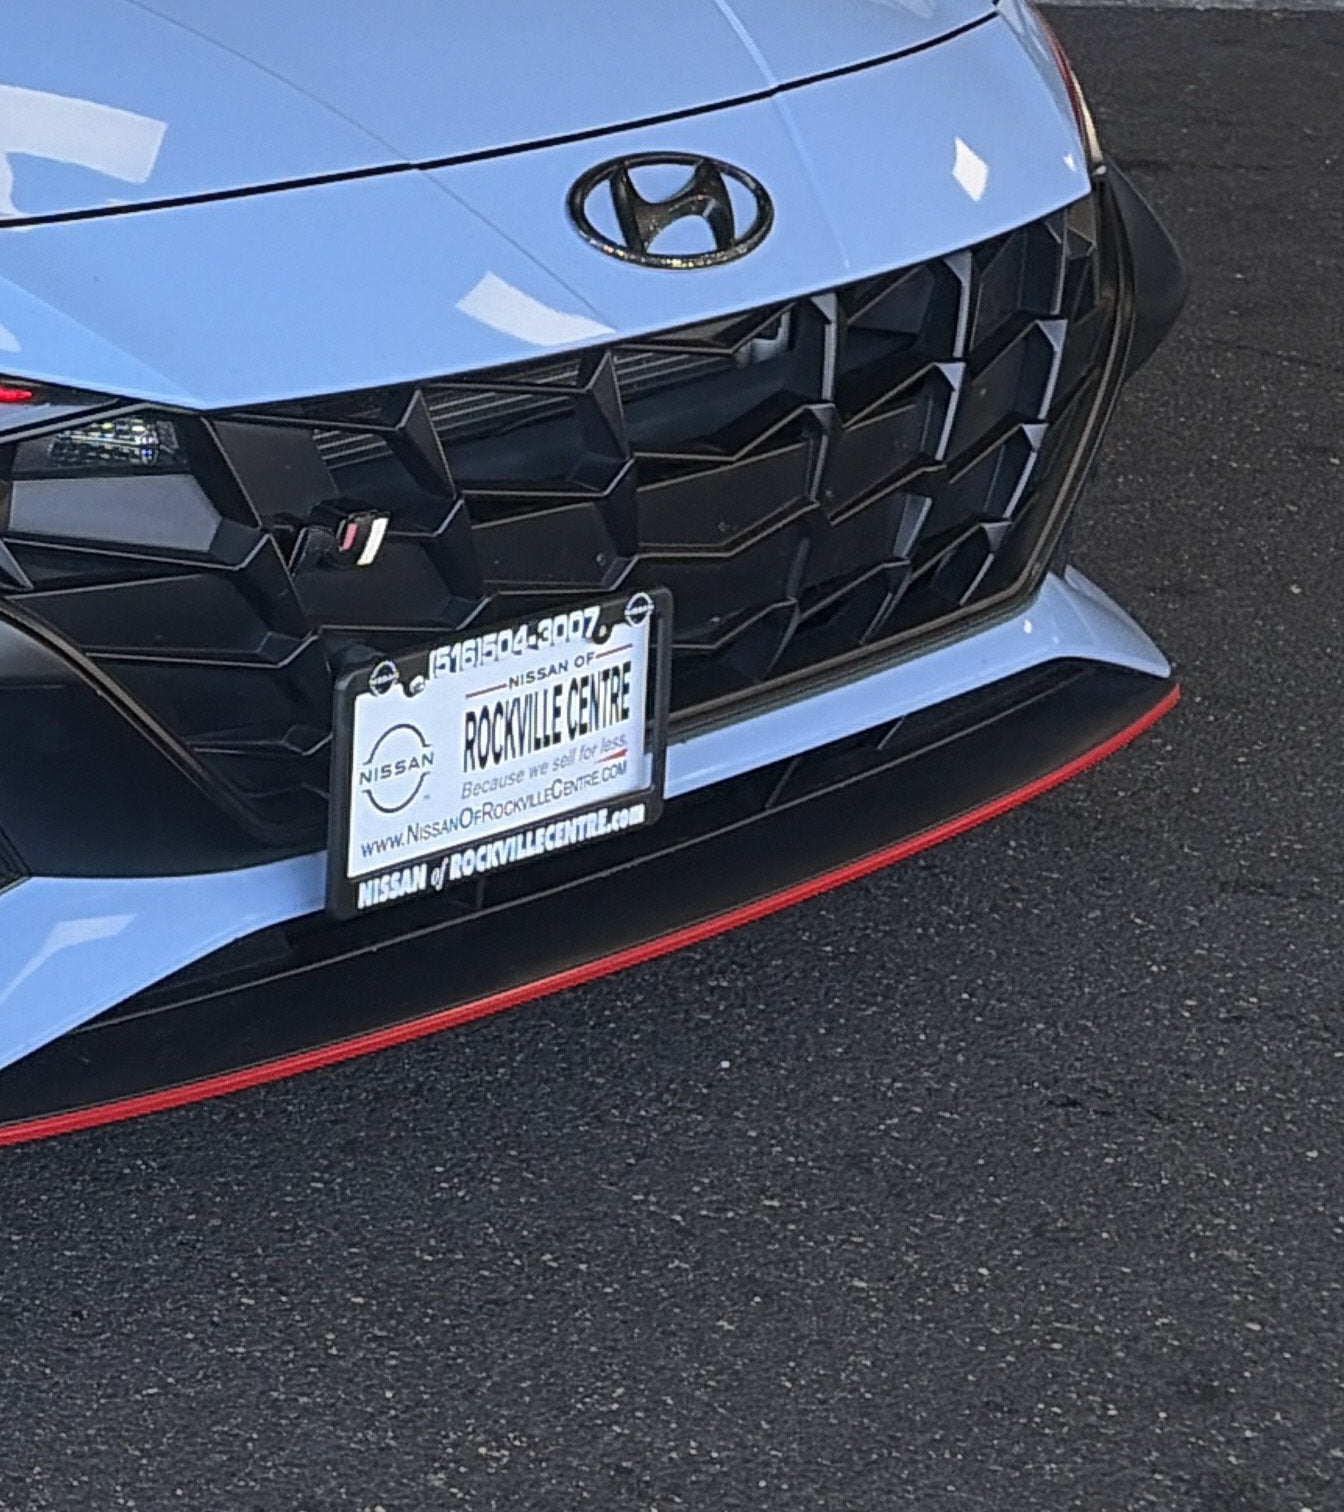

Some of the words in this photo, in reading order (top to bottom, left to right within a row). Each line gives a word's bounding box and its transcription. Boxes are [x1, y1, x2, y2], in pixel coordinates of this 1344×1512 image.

[508, 659, 569, 690] NISSAN
[574, 651, 596, 669] OF
[463, 683, 563, 774] ROCKVILLE
[566, 660, 632, 742] CENTRE
[359, 751, 435, 786] NISSAN
[461, 766, 526, 800] Because
[528, 761, 549, 779] we
[552, 746, 576, 772] sell
[578, 743, 599, 763] for
[357, 863, 428, 910] NISSAN
[430, 856, 449, 891] of
